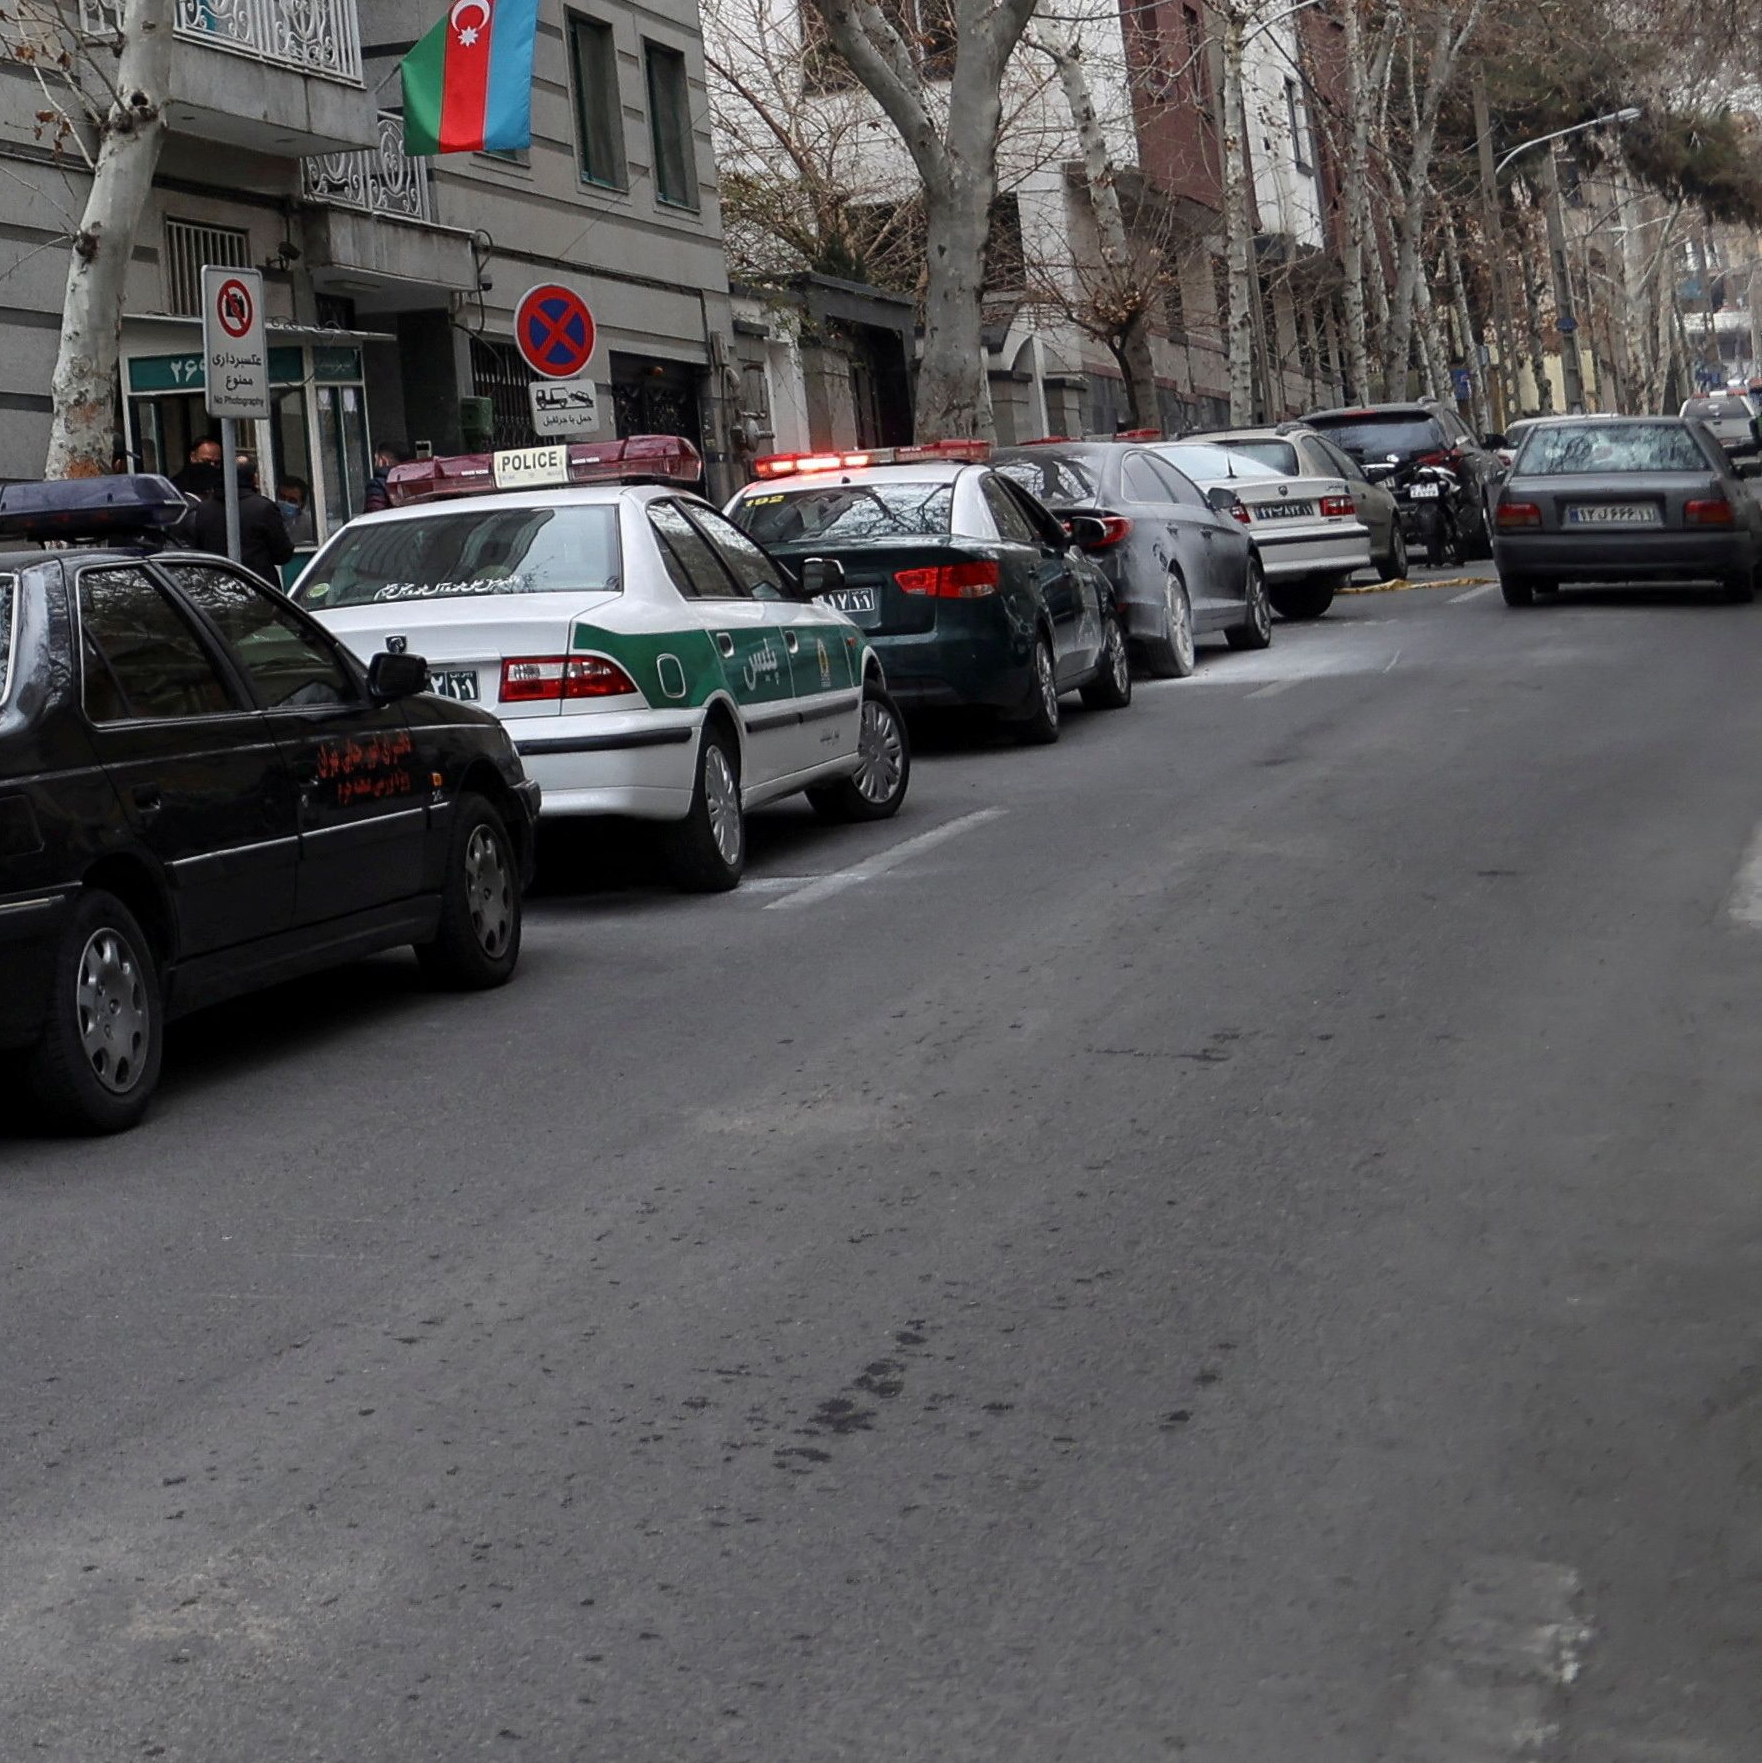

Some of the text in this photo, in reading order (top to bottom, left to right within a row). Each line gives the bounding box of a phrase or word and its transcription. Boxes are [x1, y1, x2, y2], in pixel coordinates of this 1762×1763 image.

[212, 352, 262, 369] عکسبرداری
[226, 375, 254, 391] ممنوع
[214, 395, 264, 408] No Photography
[502, 451, 558, 472] POLICE
[743, 638, 779, 691] پلیس
